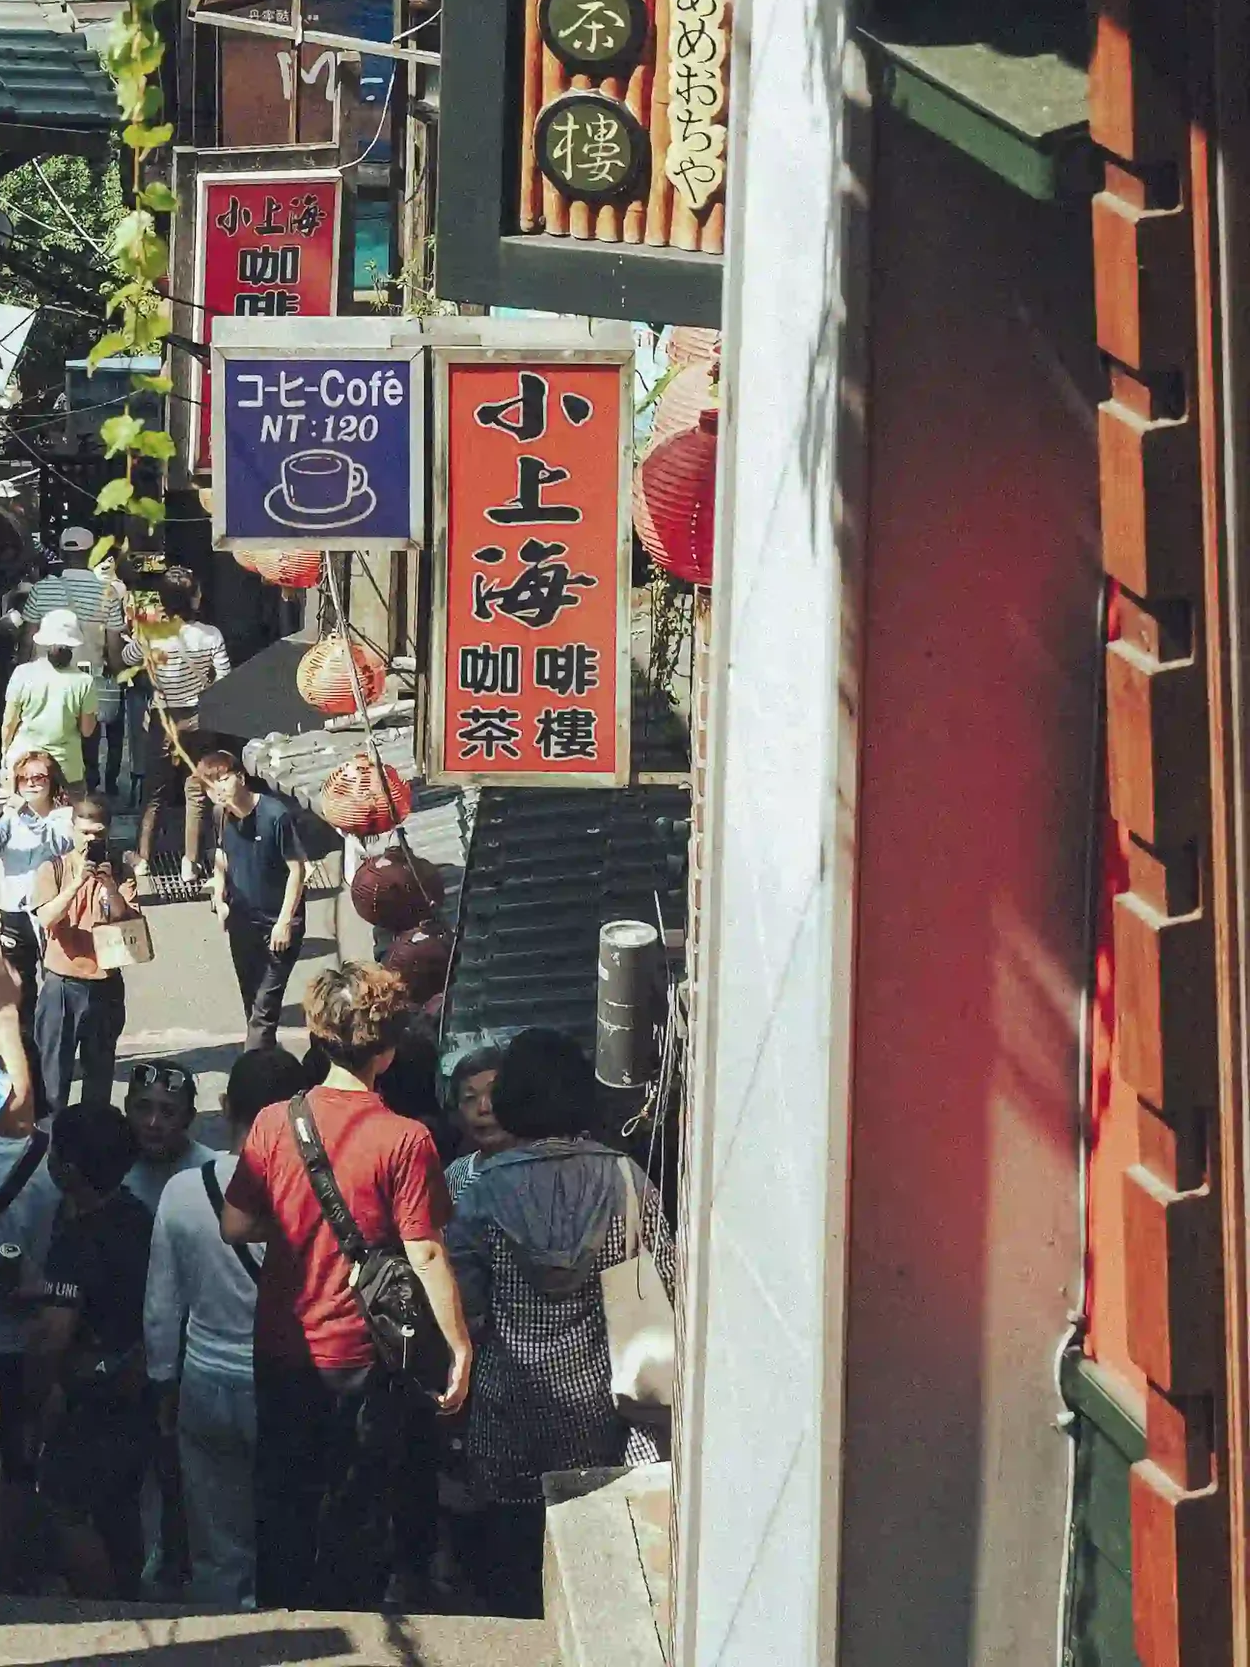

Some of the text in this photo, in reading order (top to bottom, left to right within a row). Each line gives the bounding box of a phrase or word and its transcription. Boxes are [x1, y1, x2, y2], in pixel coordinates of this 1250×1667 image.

[215, 194, 327, 238] 小上海
[474, 372, 599, 630] 小上海
[459, 644, 600, 697] 咖啡
[459, 708, 599, 761] 茶樓
